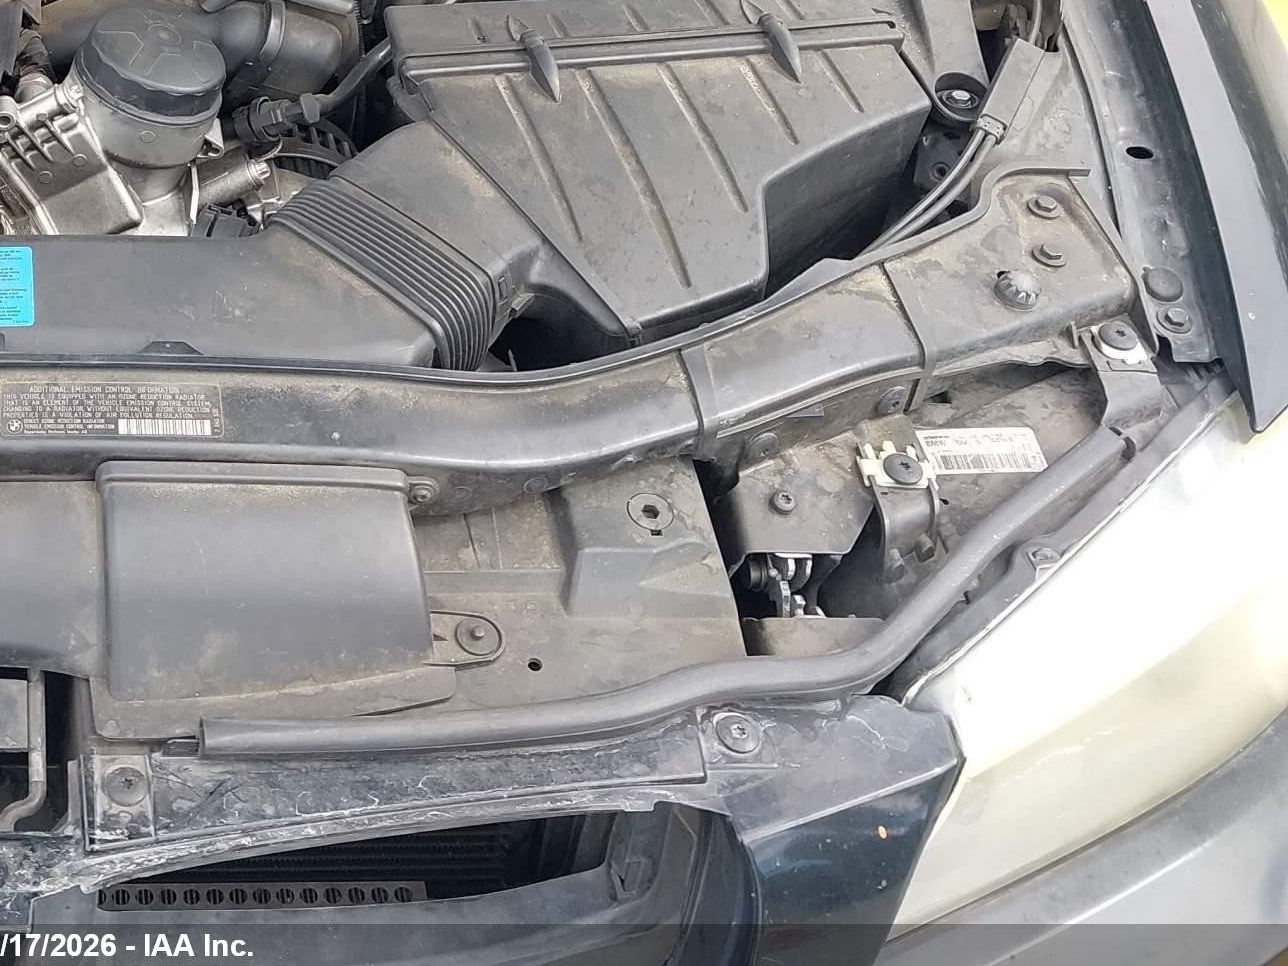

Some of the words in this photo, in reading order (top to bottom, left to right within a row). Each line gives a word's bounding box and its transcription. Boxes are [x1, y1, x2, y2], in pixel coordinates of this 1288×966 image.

[29, 385, 66, 393] ADDITIONAL
[72, 385, 101, 393] EMISSION
[137, 386, 179, 394] INFORMATION
